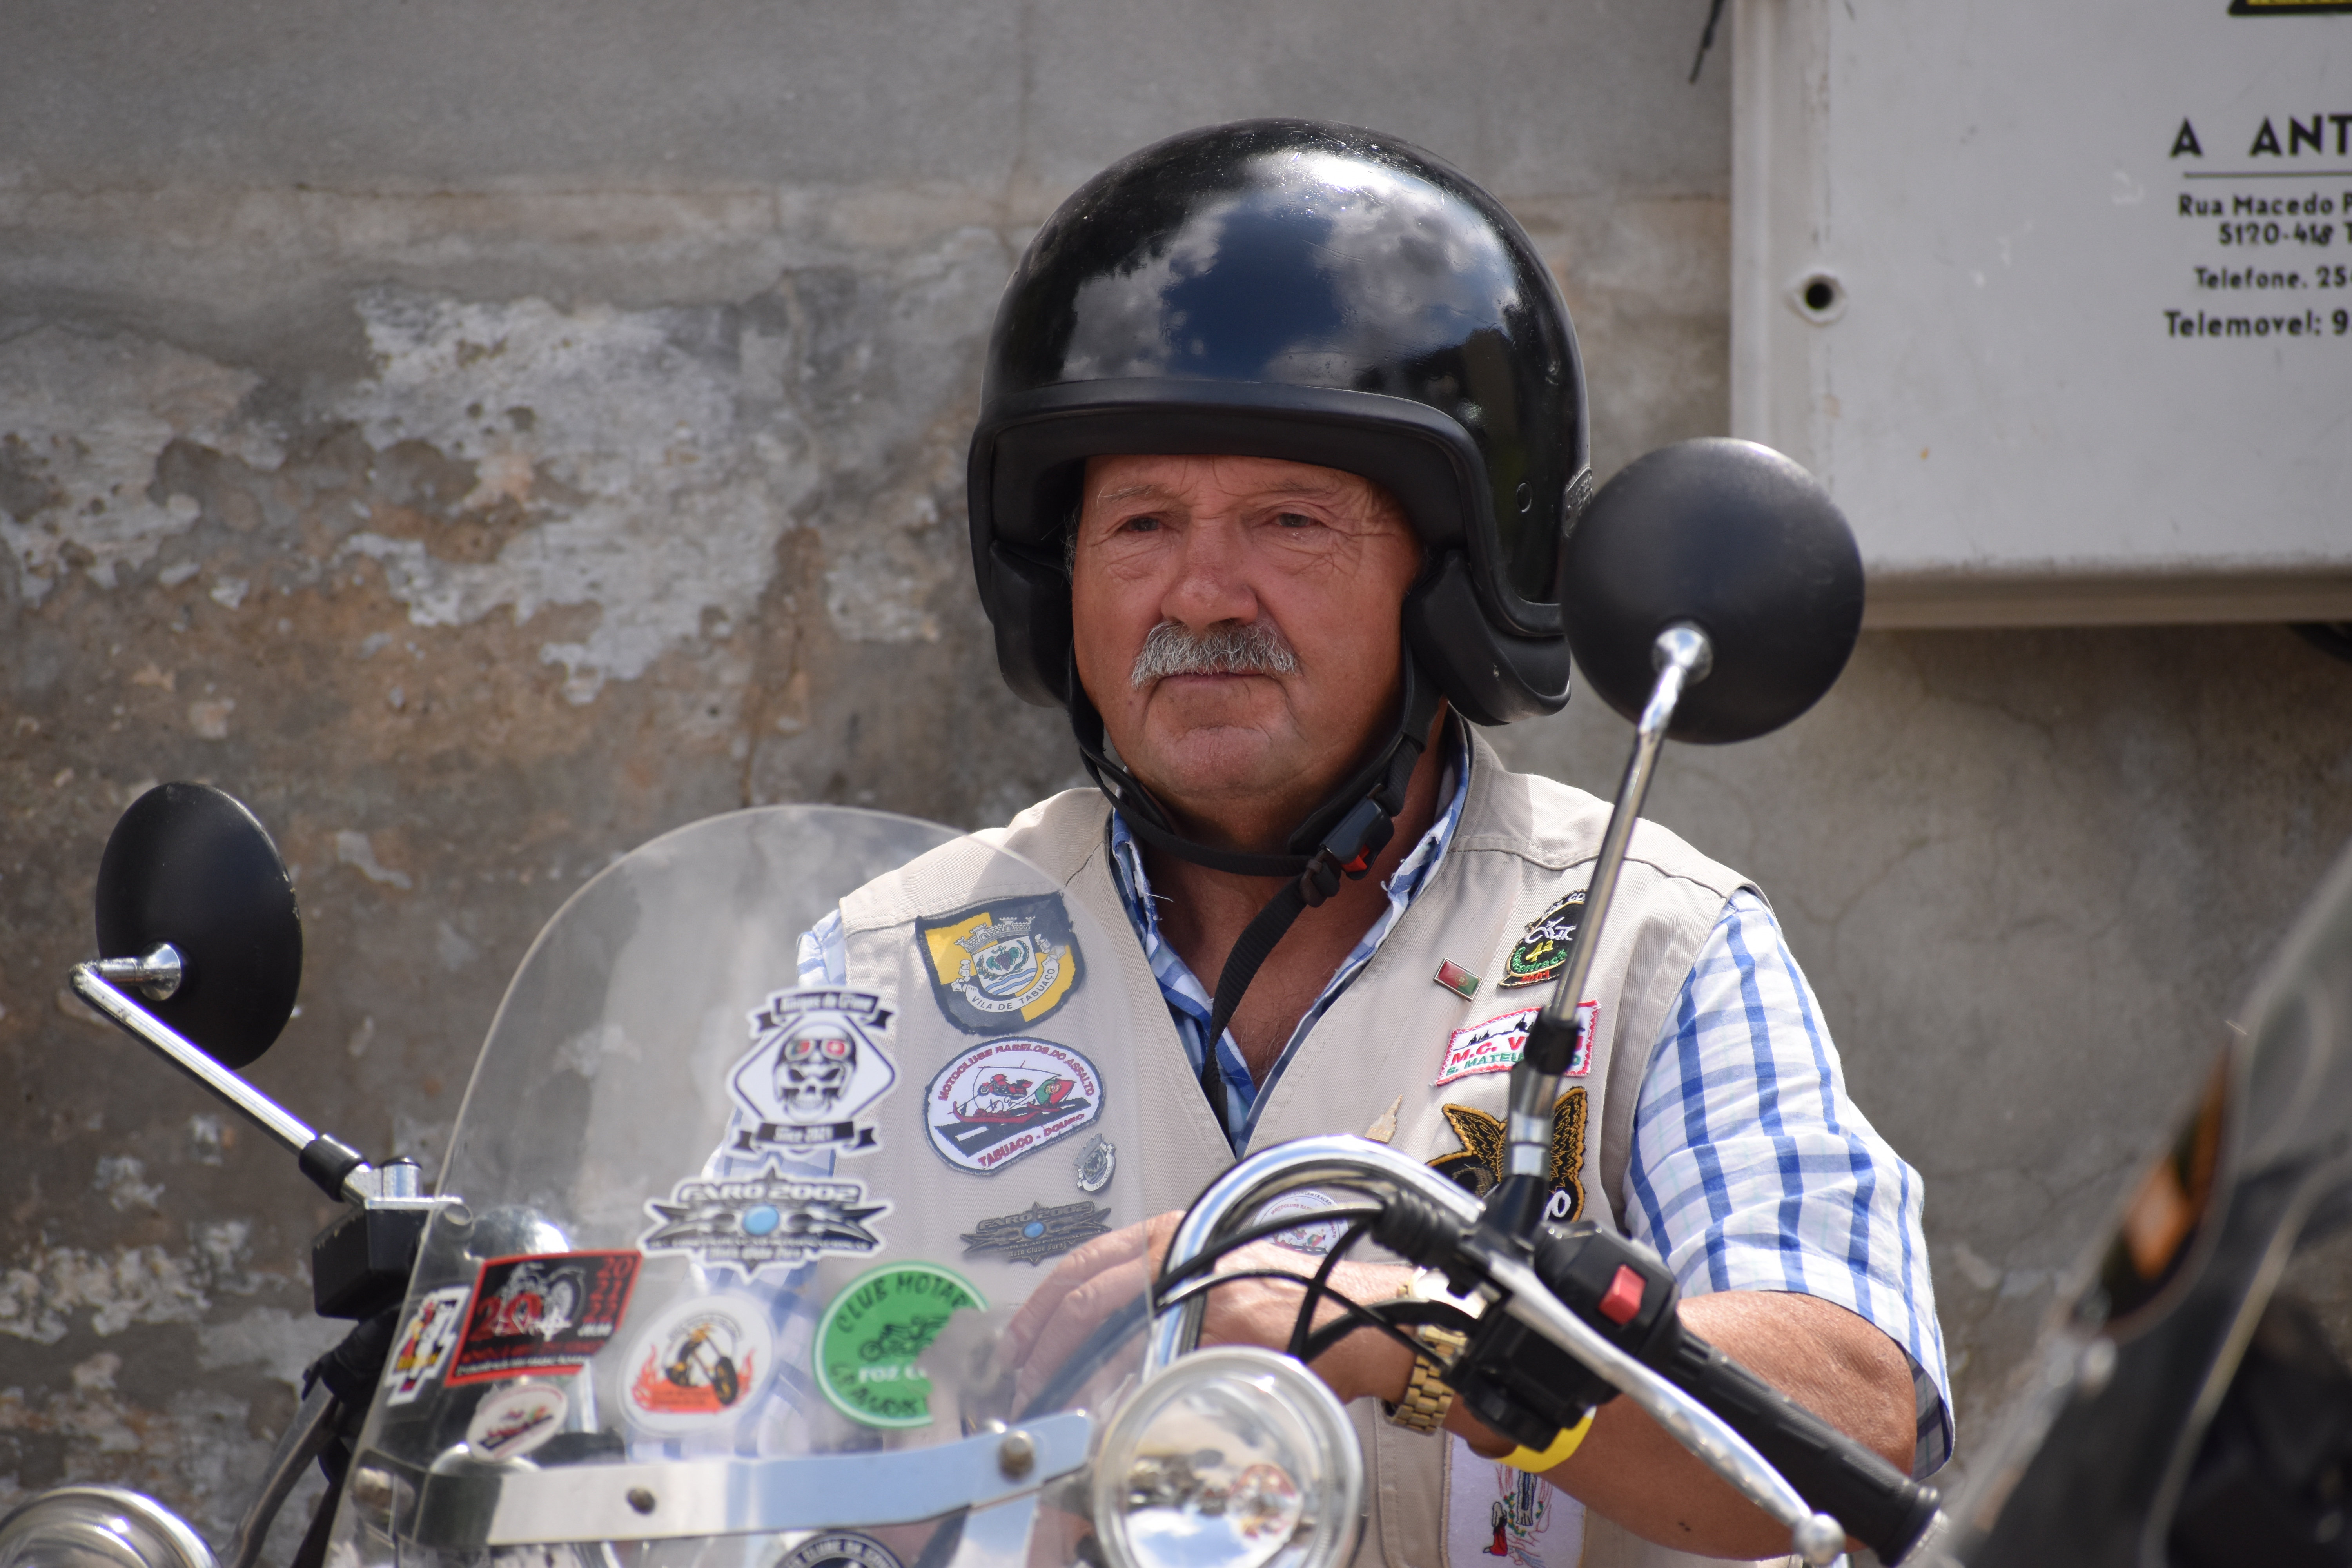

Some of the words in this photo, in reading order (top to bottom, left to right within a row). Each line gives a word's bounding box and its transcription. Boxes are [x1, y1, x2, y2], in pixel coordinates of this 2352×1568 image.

[2171, 116, 2203, 158] A
[2178, 194, 2223, 217] Rua
[2232, 192, 2334, 217] Macedo
[2194, 266, 2308, 290] Telefone.
[2316, 265, 2352, 288] 25
[2163, 309, 2321, 338] Telemovel:
[2332, 308, 2352, 336] 9
[972, 996, 993, 1010] VILA
[998, 1002, 1013, 1011] DE
[1018, 968, 1055, 1004] TABUAÇO
[1450, 1042, 1497, 1066] M.C.
[1464, 1053, 1525, 1069] MATEU
[938, 1048, 993, 1101] MOTOCLUBE
[995, 1044, 1049, 1055] RABELOS
[1051, 1049, 1067, 1061] DO
[1064, 1058, 1095, 1096] ASSALTO
[1043, 1113, 1085, 1137] DOURO
[679, 1184, 767, 1201] FARO
[769, 1184, 860, 1202] 2002
[979, 1213, 1033, 1230] FARO
[1037, 1201, 1093, 1218] 2002
